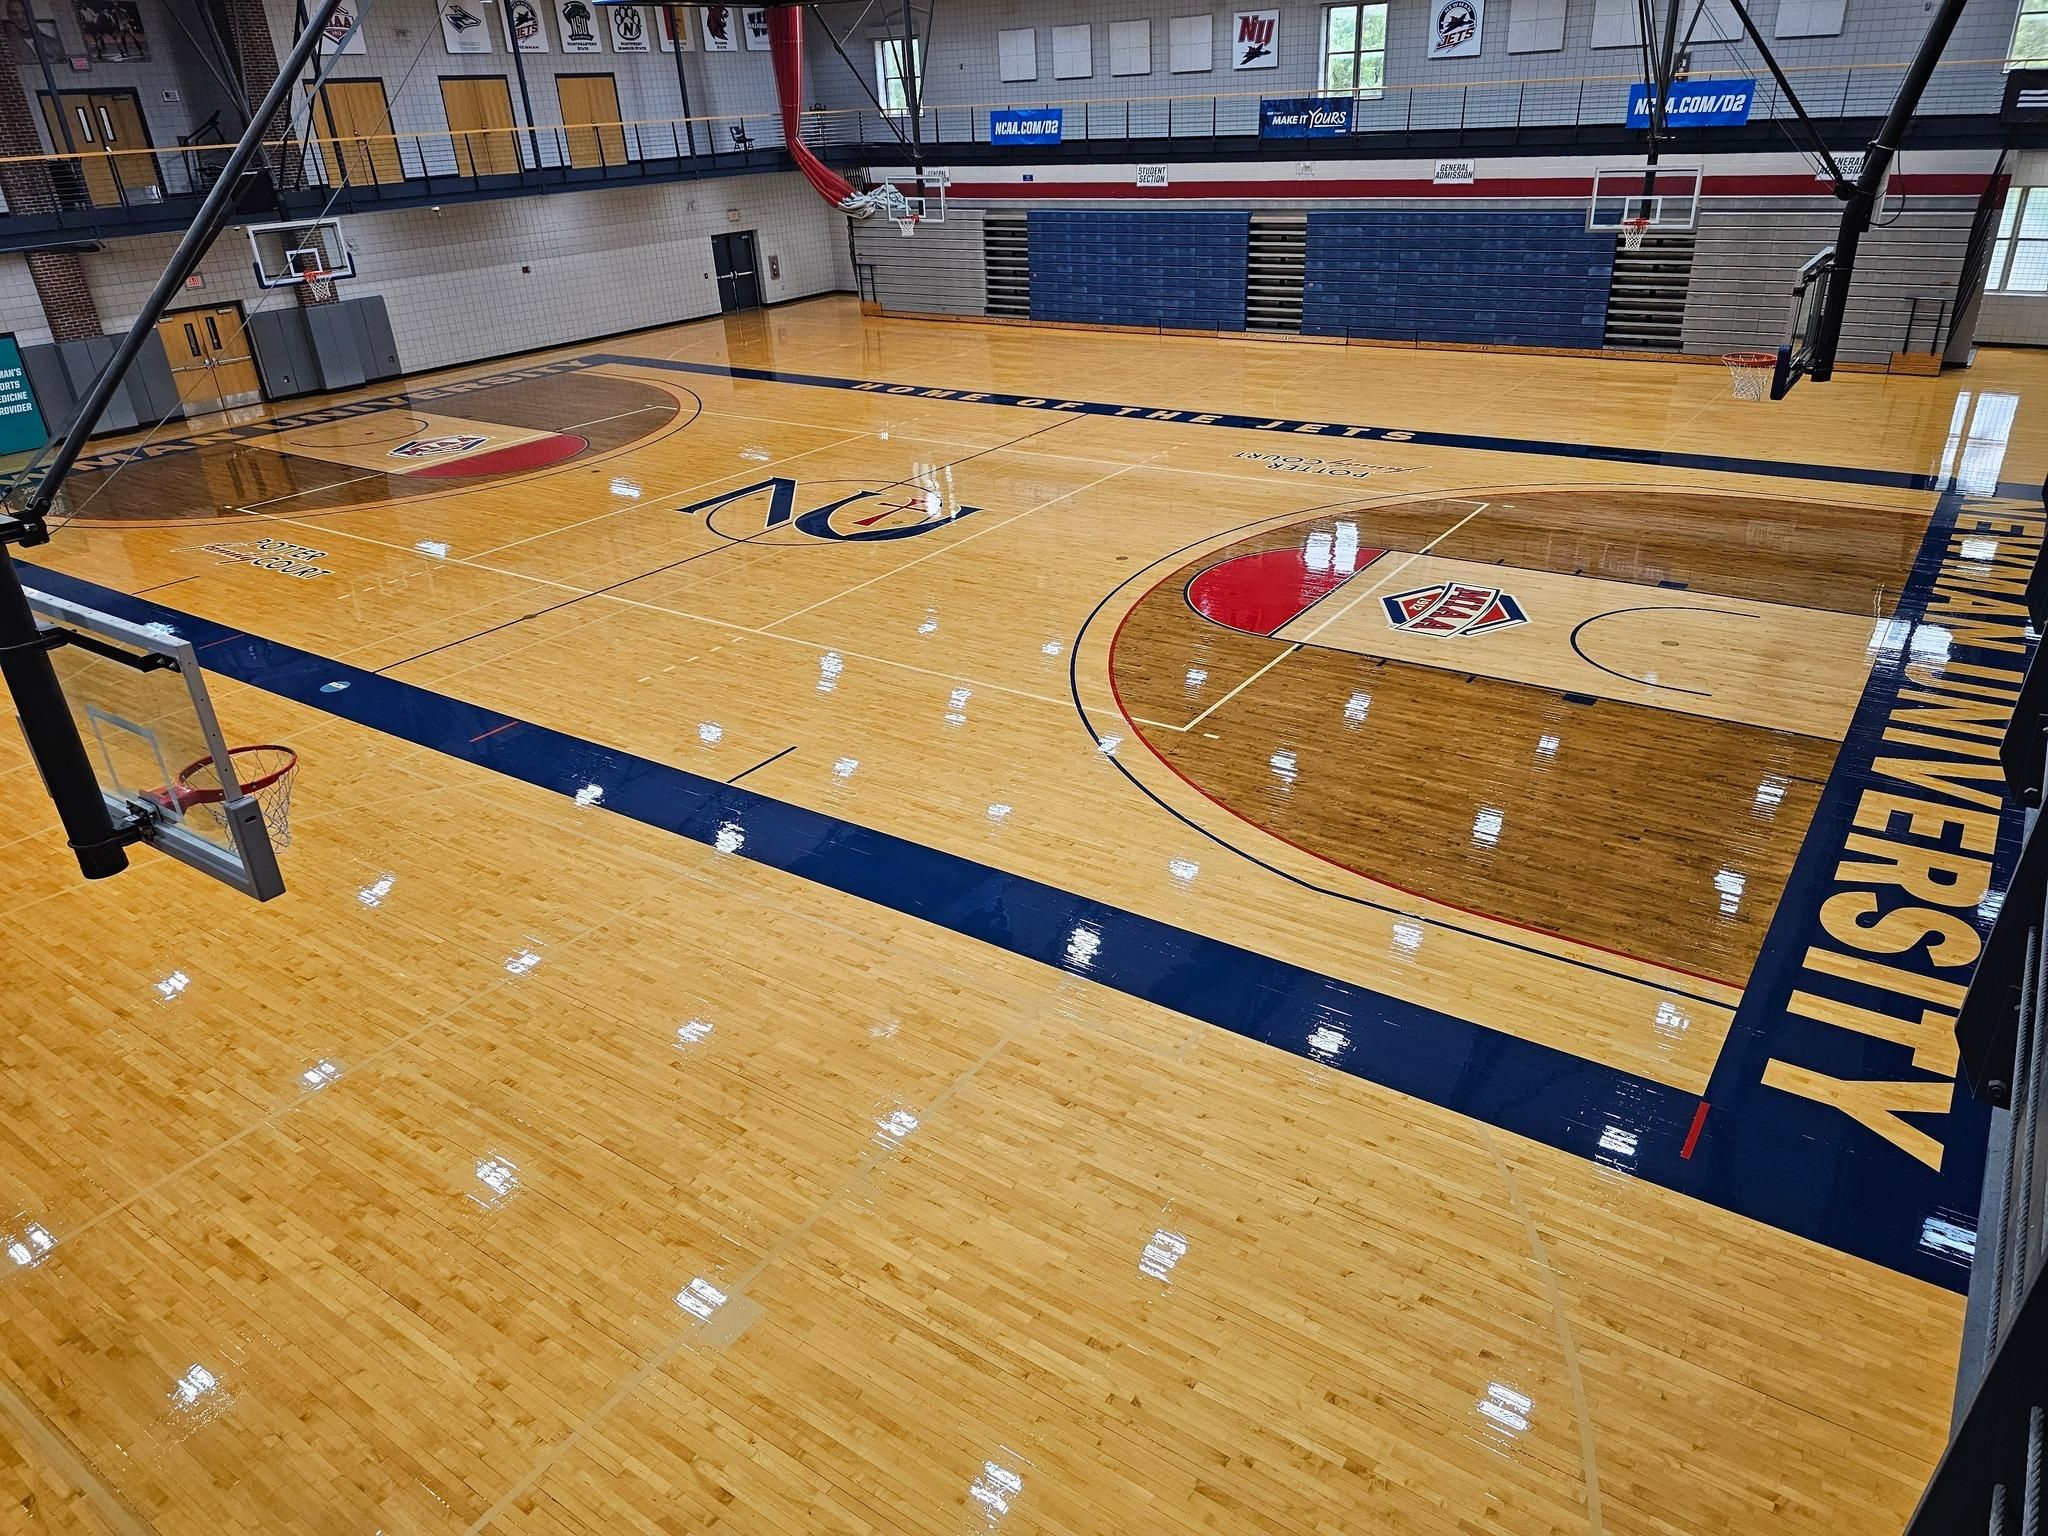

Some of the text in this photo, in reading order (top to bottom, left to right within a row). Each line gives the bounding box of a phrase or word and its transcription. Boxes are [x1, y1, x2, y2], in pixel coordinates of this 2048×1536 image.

[1444, 2, 1472, 14] NEWMAN
[570, 16, 588, 36] NSU
[623, 23, 634, 37] N
[1238, 15, 1276, 45] NU
[1437, 25, 1476, 48] JETS
[1634, 94, 1747, 115] NCA.COM/D2
[995, 120, 1059, 136] NCAA.COM/D2
[1272, 107, 1347, 129] MAKE IT YOURS
[1138, 166, 1167, 175] STUDENT
[1434, 171, 1474, 181] ADMISSION
[1439, 163, 1470, 173] GENERAL
[1139, 174, 1165, 184] SECTION
[850, 381, 1417, 442] HOME OF THE JETS
[1266, 462, 1370, 480] POTTER
[253, 537, 328, 562] POTTER
[252, 556, 336, 580] COURT
[1409, 585, 1493, 632] MIAA
[1760, 658, 2027, 1174] UNIVERSITY
